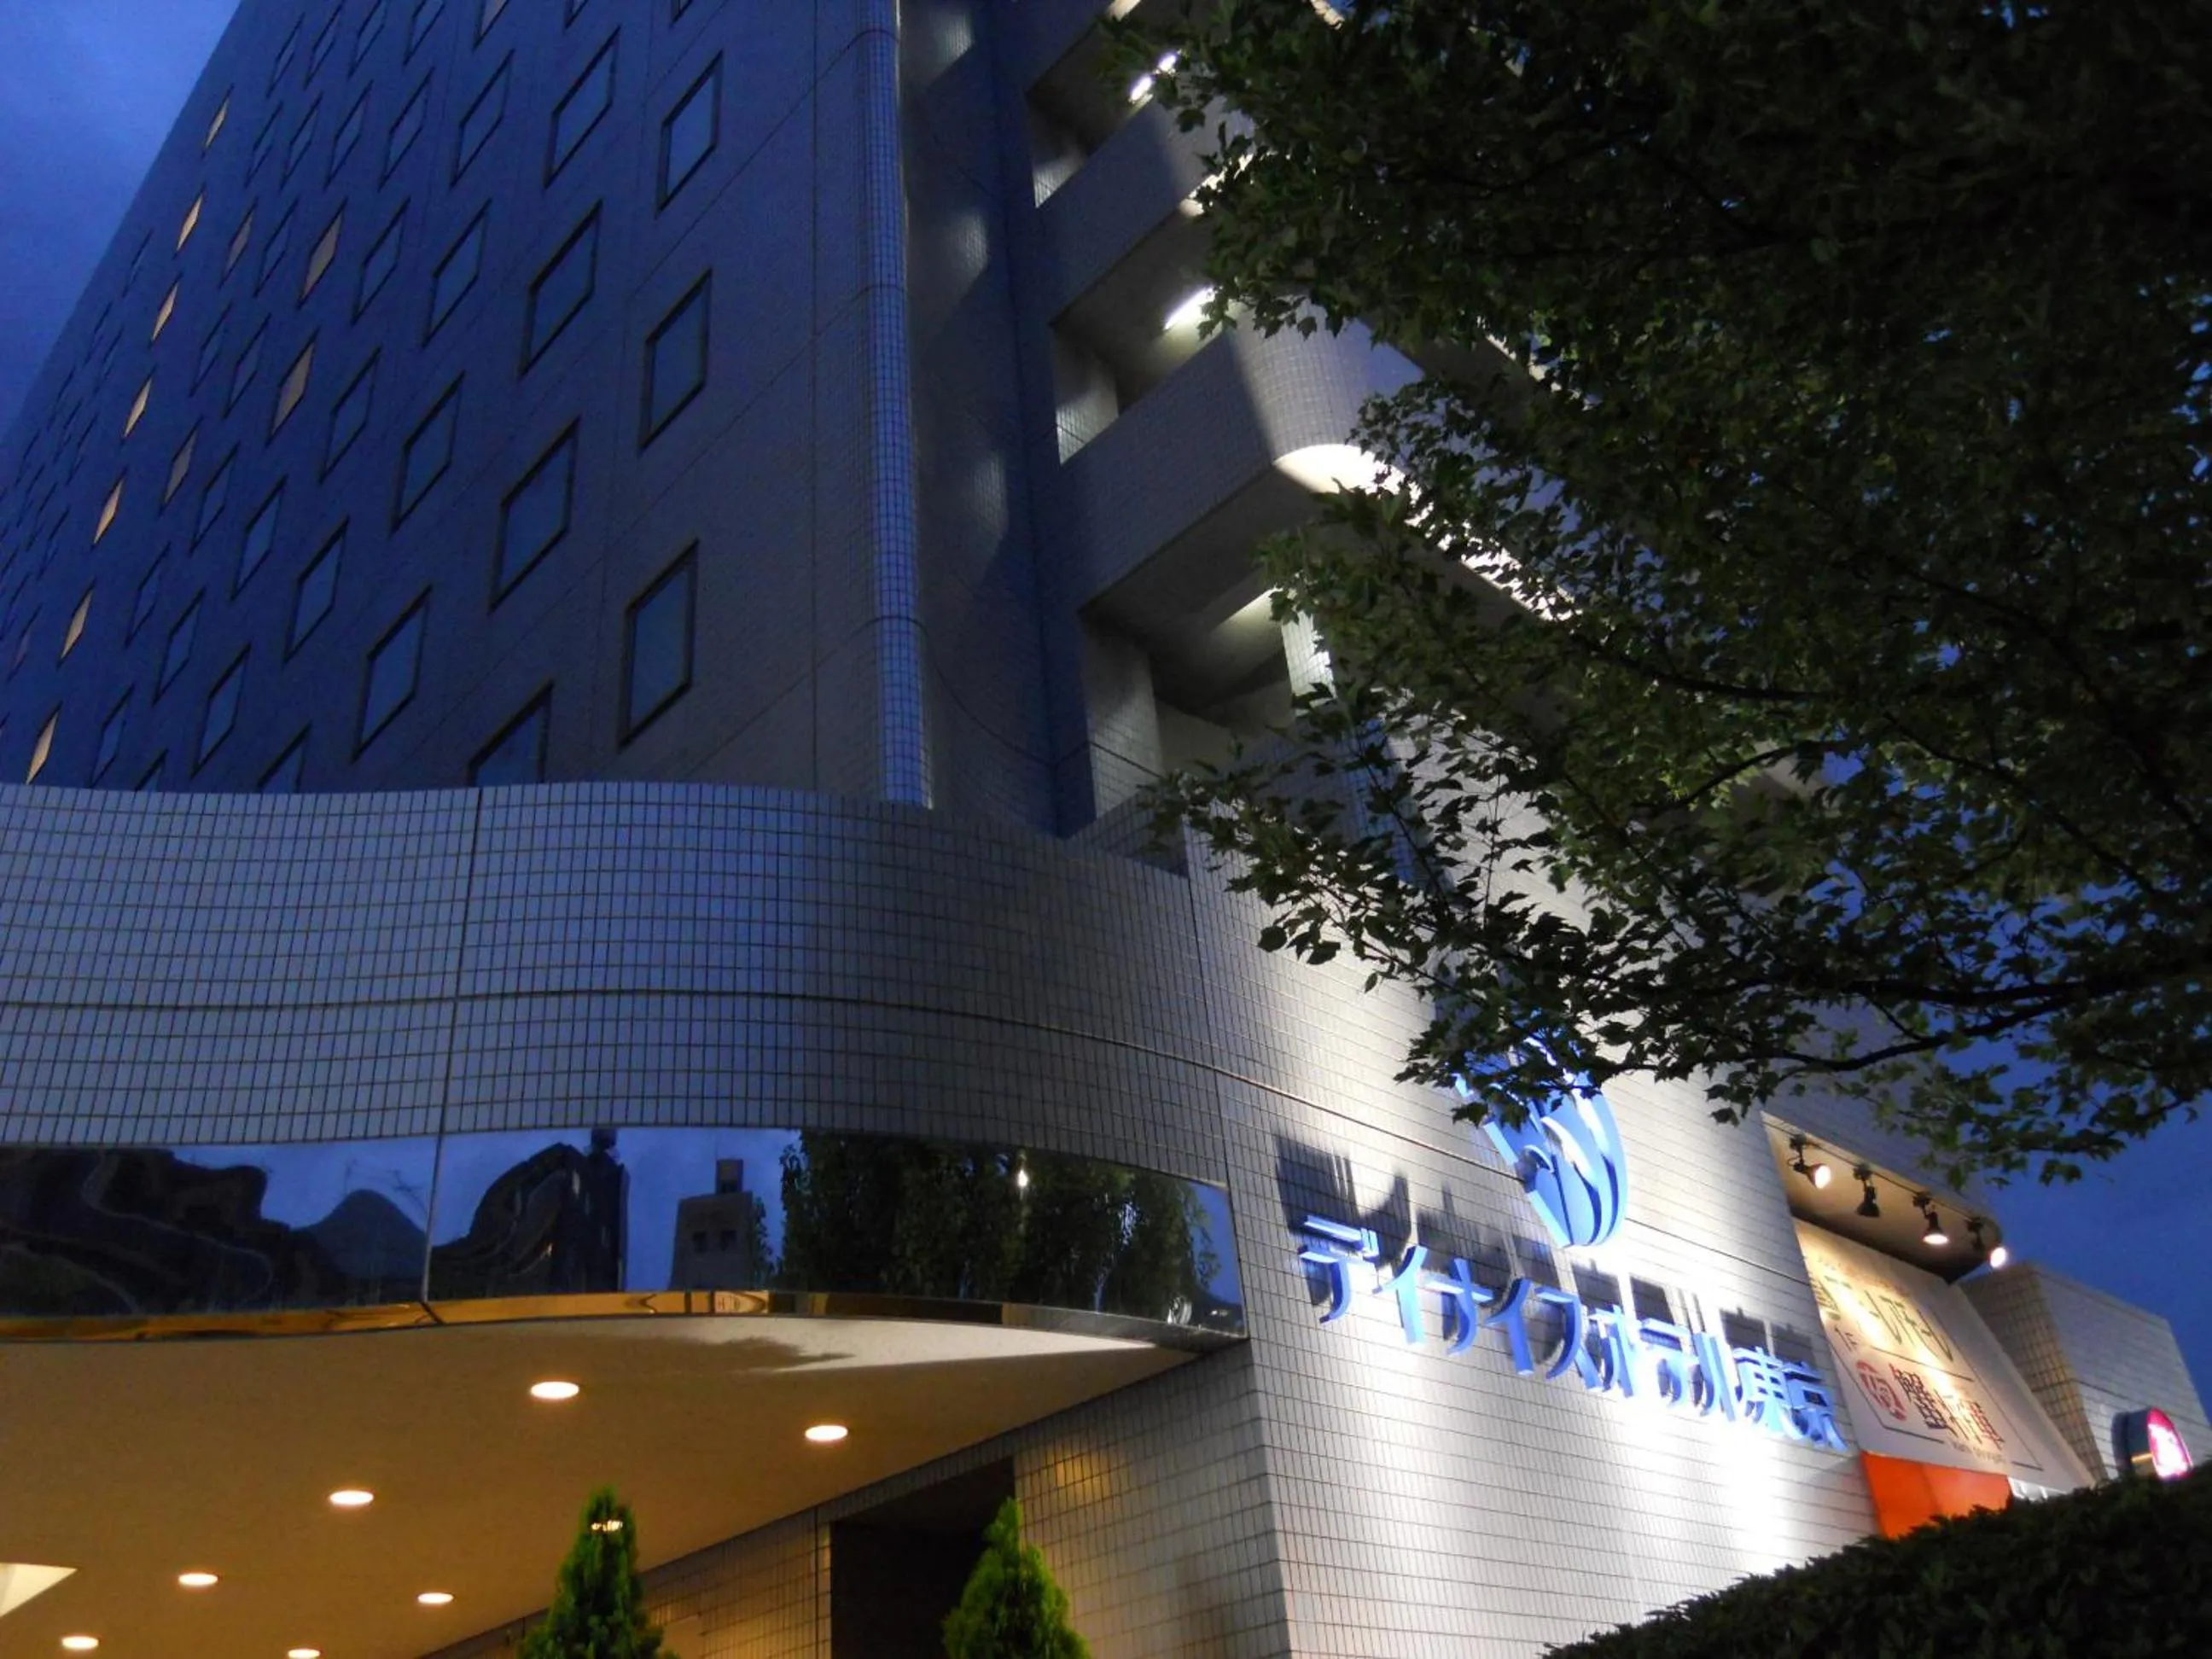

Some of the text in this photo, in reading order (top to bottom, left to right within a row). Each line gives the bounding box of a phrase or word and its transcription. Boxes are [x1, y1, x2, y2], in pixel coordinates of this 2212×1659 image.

[1298, 1215, 1847, 1450] デイナイスホテル東京
